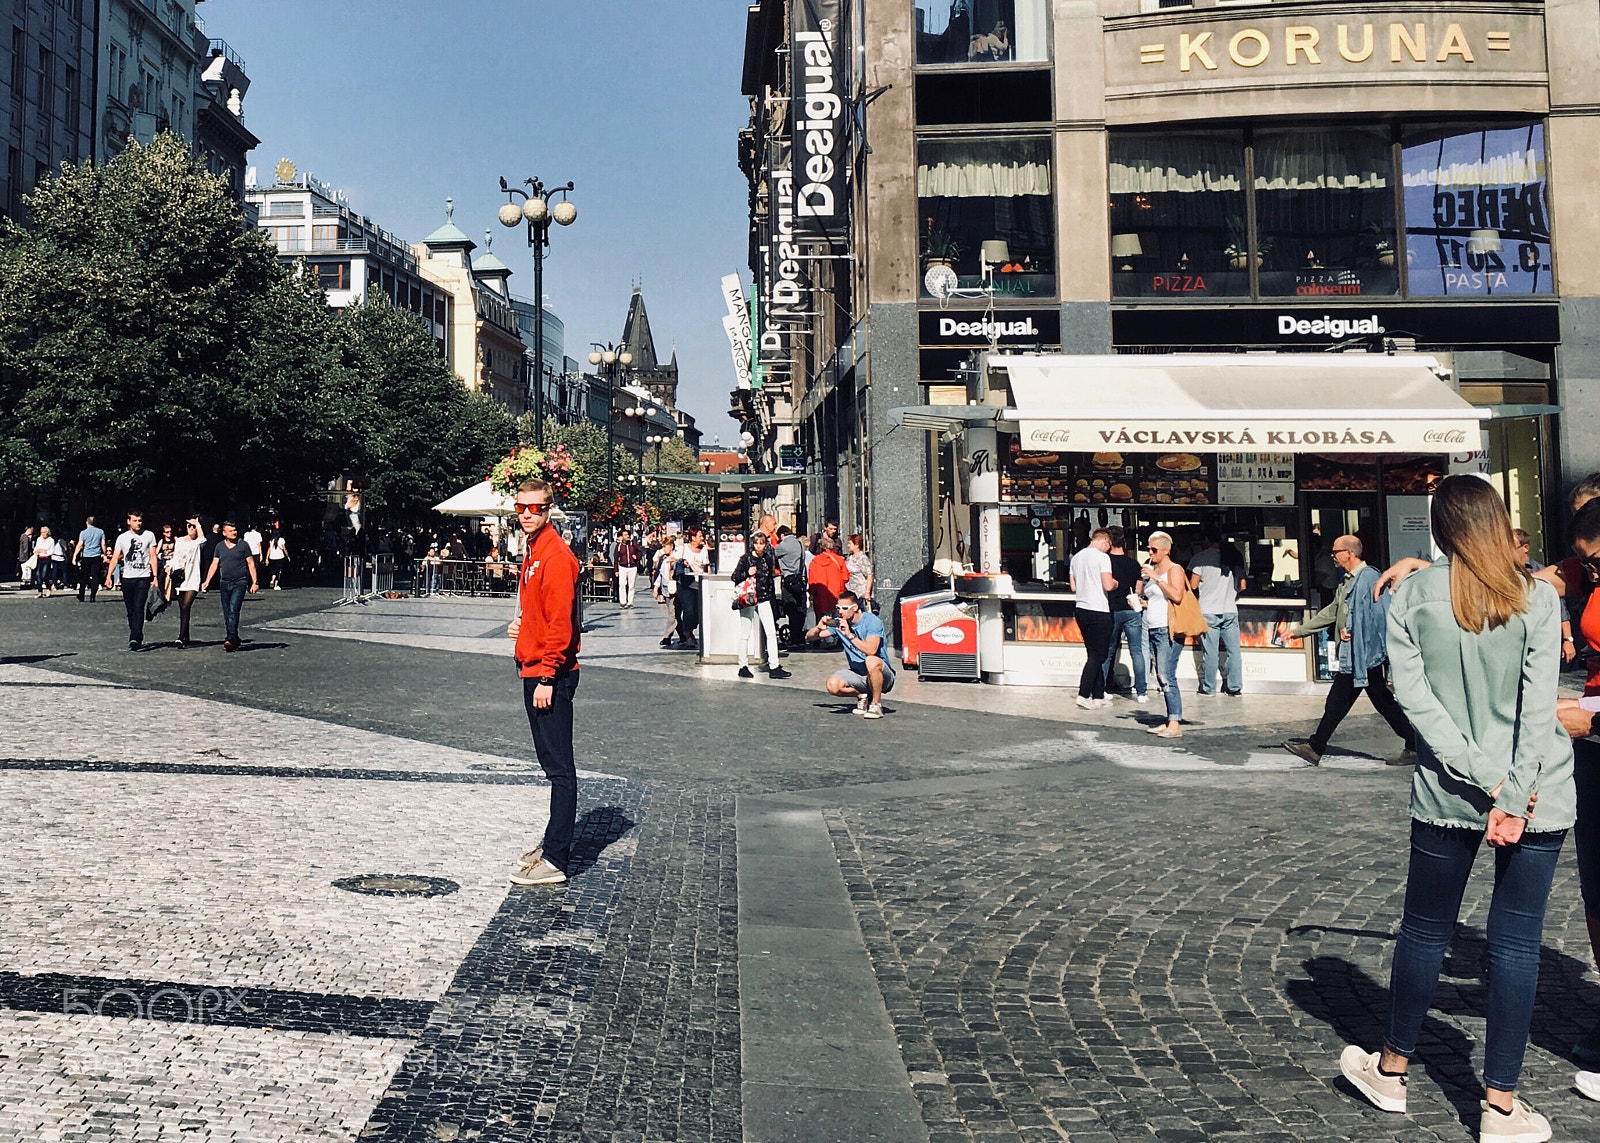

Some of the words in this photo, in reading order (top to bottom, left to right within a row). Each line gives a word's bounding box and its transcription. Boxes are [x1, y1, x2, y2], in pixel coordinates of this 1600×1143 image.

[1179, 23, 1475, 72] KORUNA
[1152, 275, 1207, 292] PIZZA
[1295, 275, 1334, 283] PIZZA
[1445, 272, 1508, 289] PASTA
[1296, 283, 1361, 295] coloseum
[729, 327, 749, 379] MANGO
[1098, 427, 1257, 445] VÁCLAVSKÁ
[1266, 427, 1396, 445] KLOBÁSA
